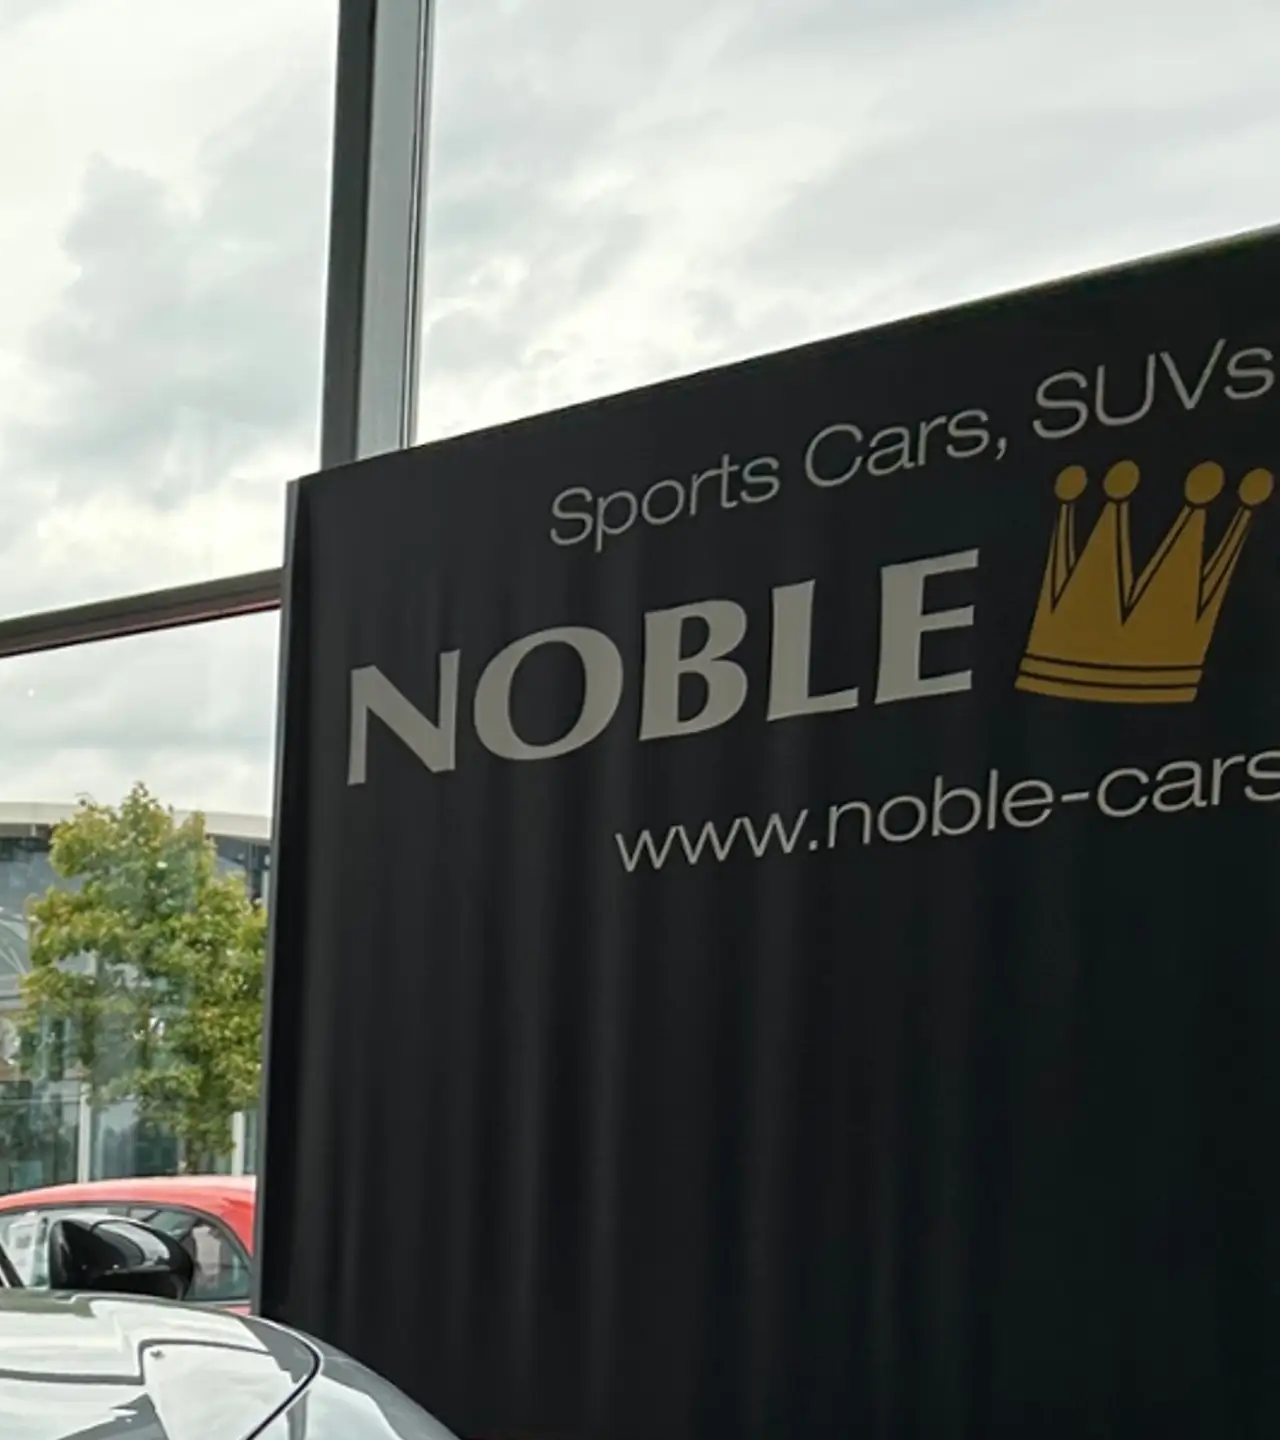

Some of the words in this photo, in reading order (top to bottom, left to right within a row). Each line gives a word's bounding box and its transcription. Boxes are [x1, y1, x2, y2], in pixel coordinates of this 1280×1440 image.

[549, 452, 781, 553] Sports
[803, 409, 1009, 489] Cars,
[1031, 337, 1278, 440] SUVs
[347, 547, 980, 786] NOBLE
